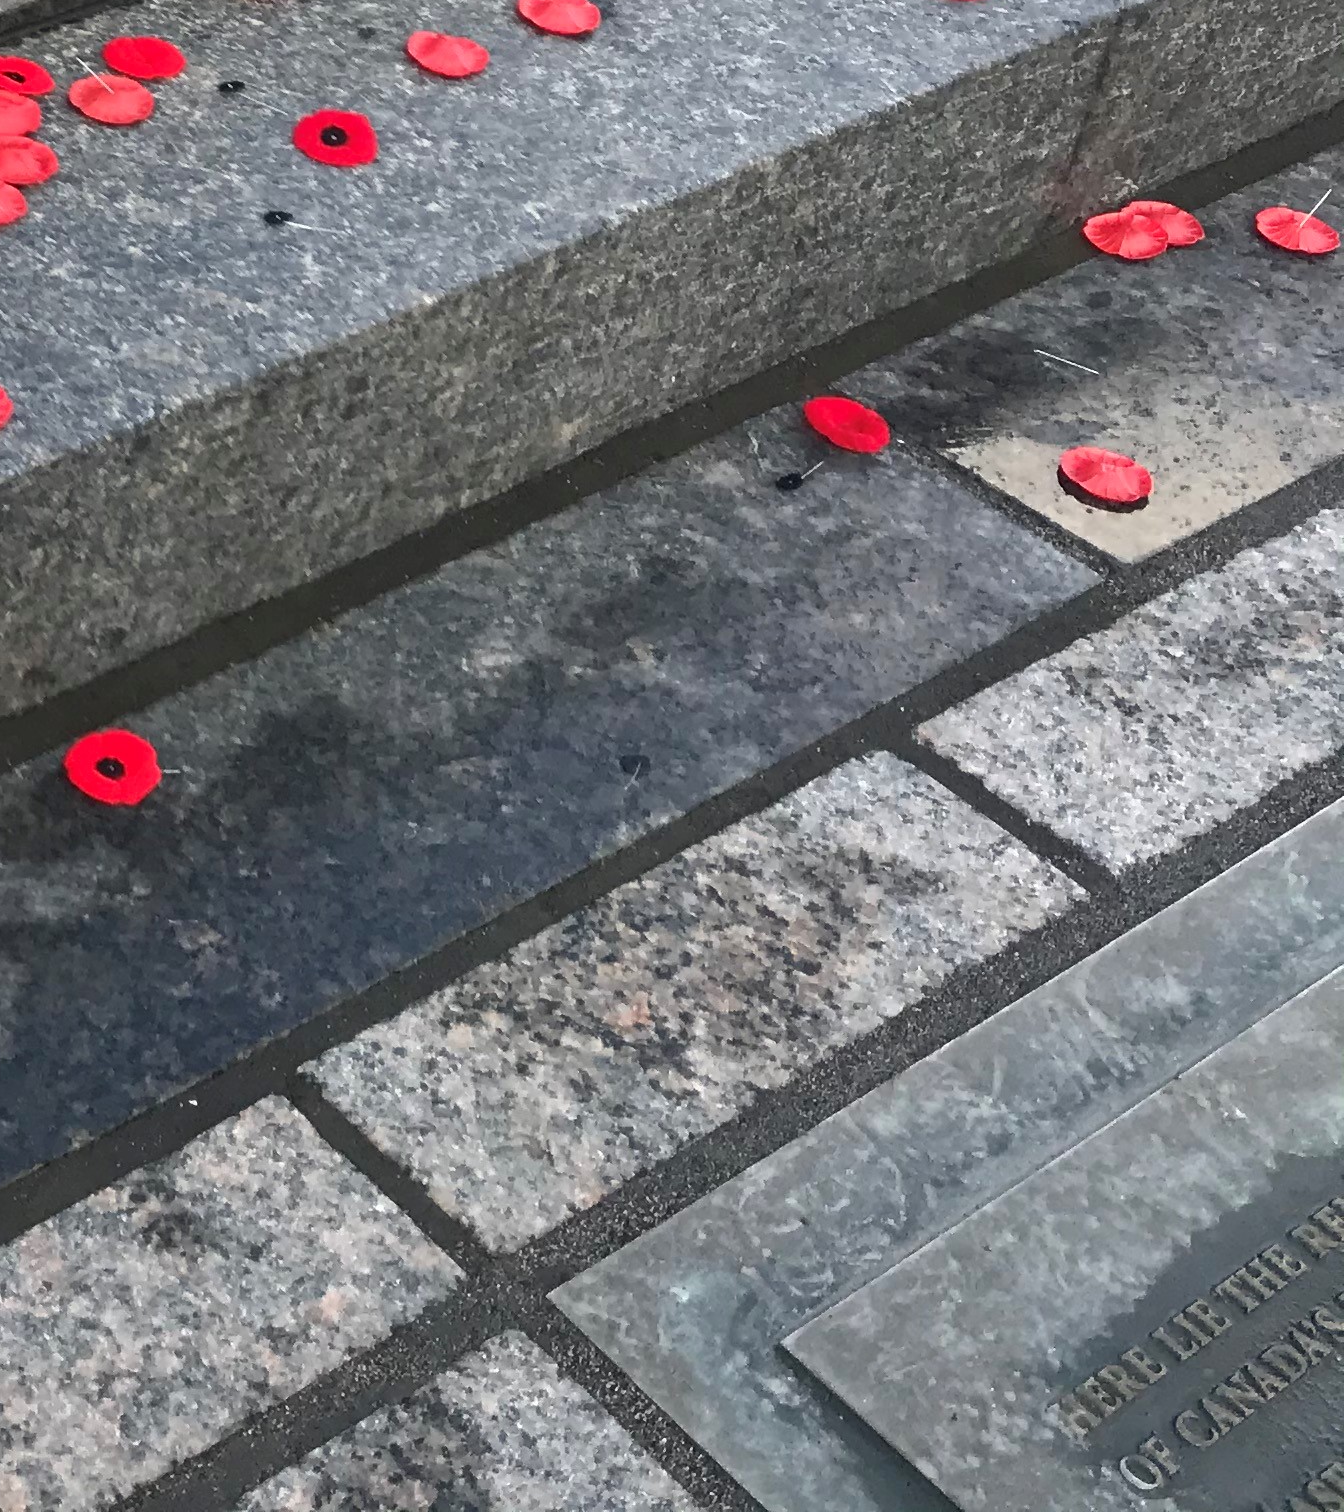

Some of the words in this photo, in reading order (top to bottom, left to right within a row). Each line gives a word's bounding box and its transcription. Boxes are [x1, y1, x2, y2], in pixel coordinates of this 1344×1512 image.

[1047, 1346, 1167, 1441] HERE
[1150, 1298, 1232, 1361] LIE
[1213, 1244, 1308, 1314] THE
[1119, 1435, 1181, 1490] OF
